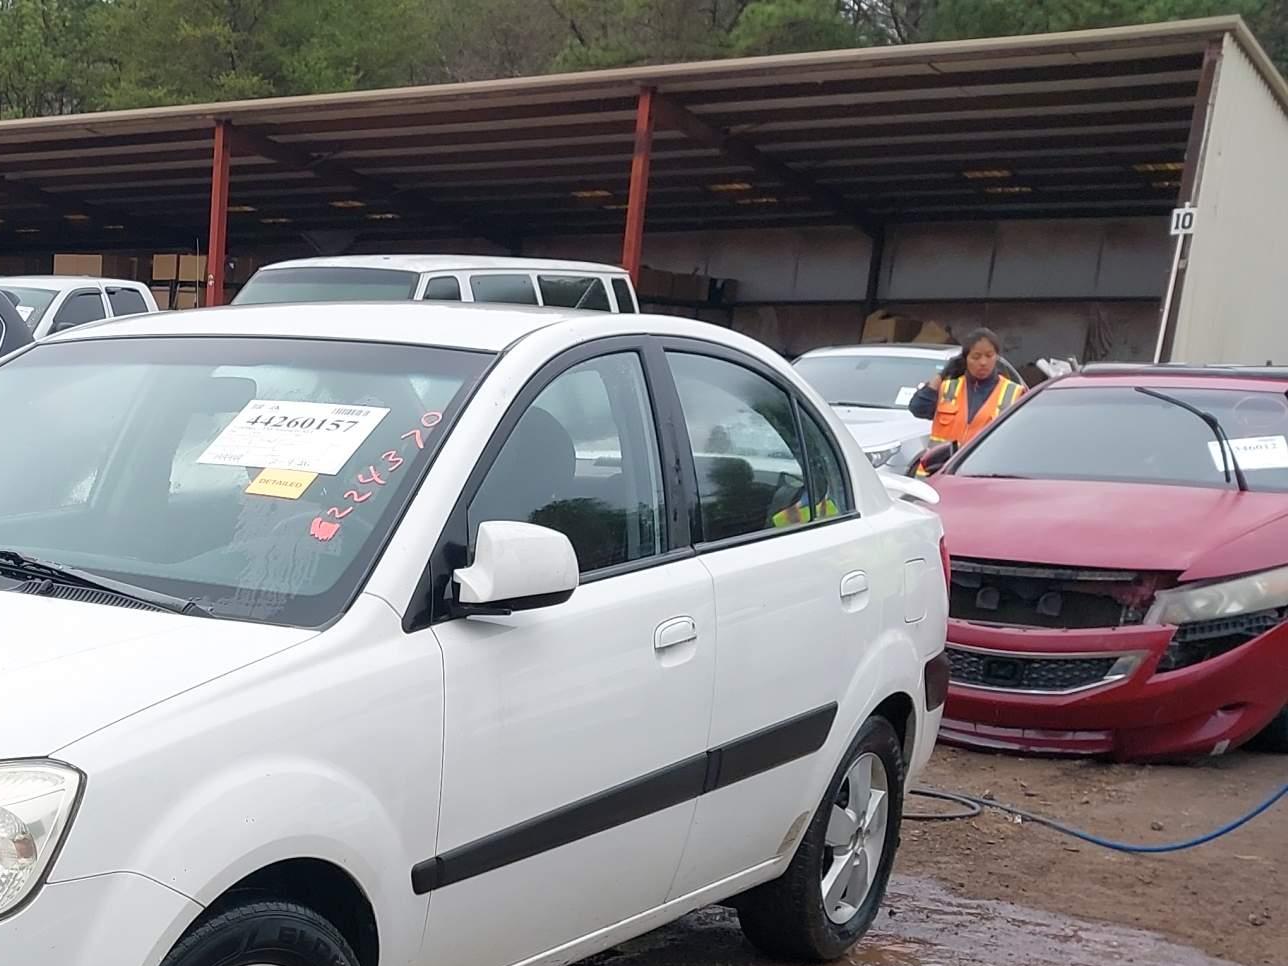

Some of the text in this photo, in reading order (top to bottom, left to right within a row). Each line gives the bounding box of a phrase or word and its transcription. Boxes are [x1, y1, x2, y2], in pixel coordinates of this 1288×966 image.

[1174, 212, 1193, 230] 10
[246, 414, 360, 433] 44260157
[259, 478, 302, 489] DETAILED
